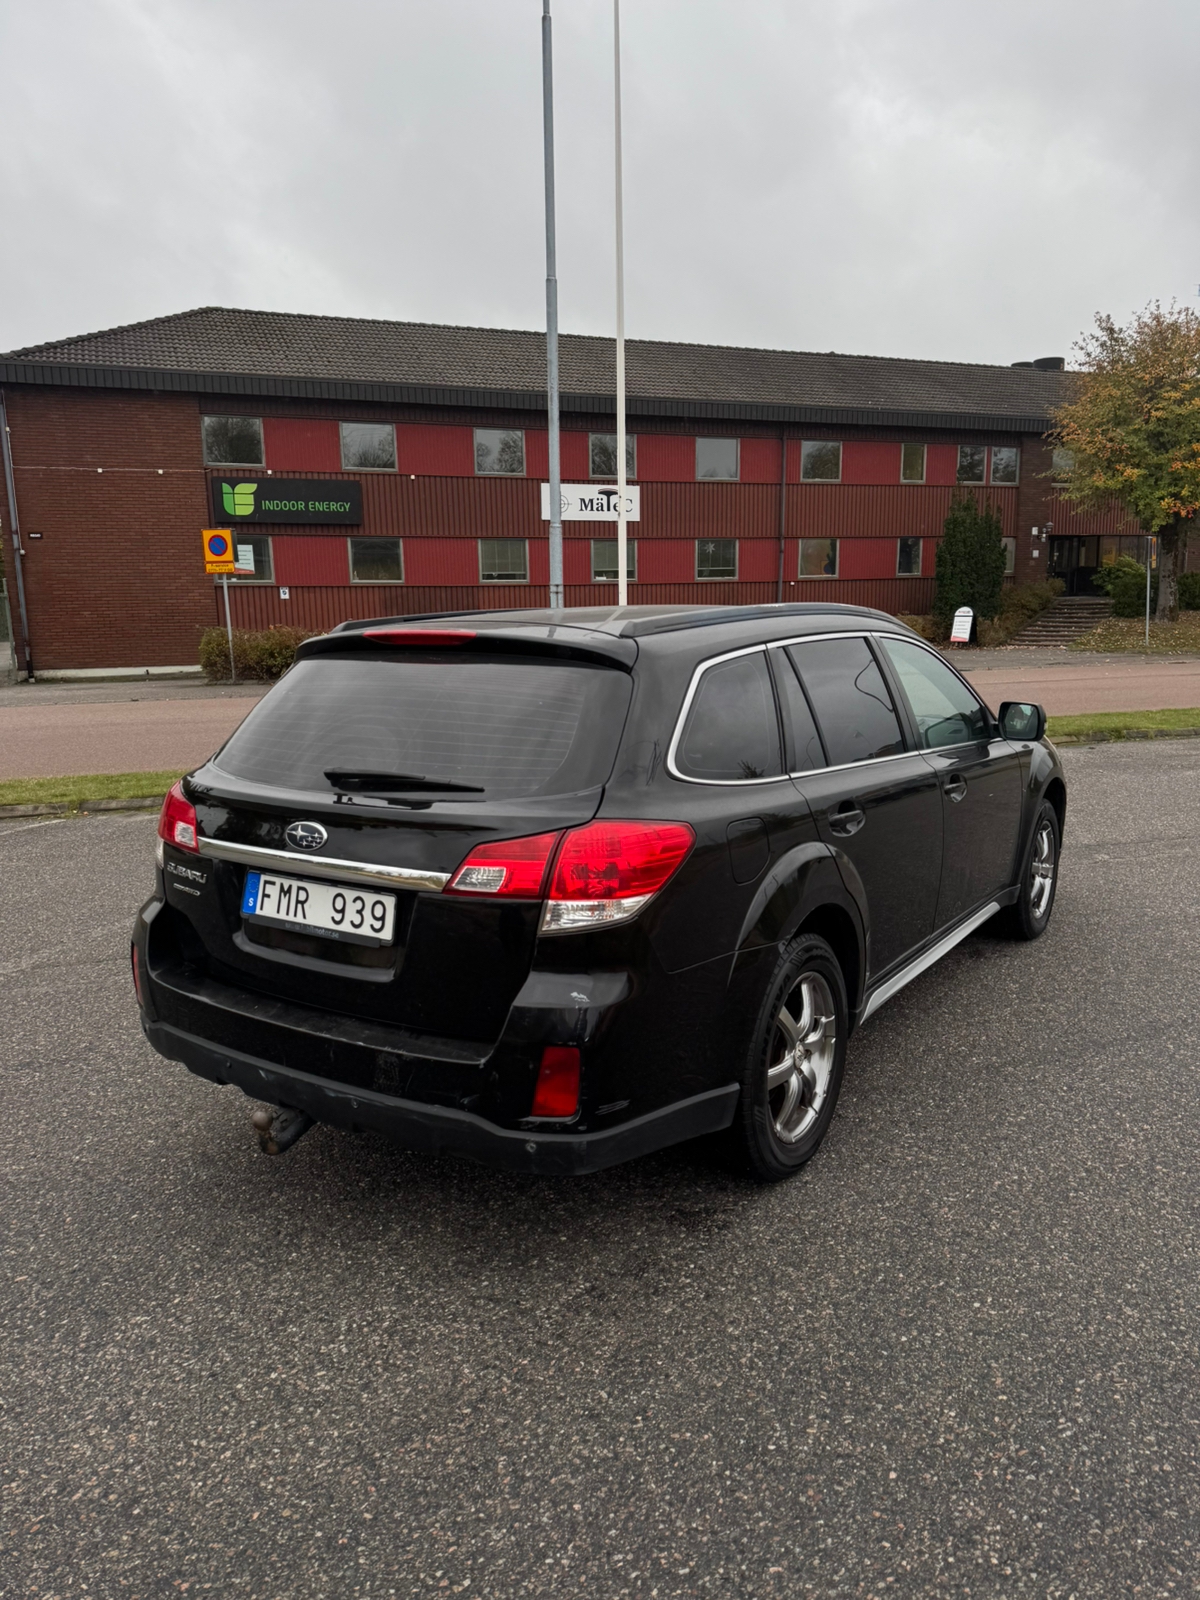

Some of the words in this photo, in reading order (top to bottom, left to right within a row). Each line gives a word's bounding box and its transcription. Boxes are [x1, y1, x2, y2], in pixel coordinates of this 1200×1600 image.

[261, 500, 305, 511] INDOOR
[308, 501, 351, 512] ENERGY
[167, 861, 207, 884] SUBARU
[248, 897, 254, 907] S
[259, 879, 309, 920] FMR
[331, 892, 387, 934] 939
[759, 973, 791, 1087] INERVA
